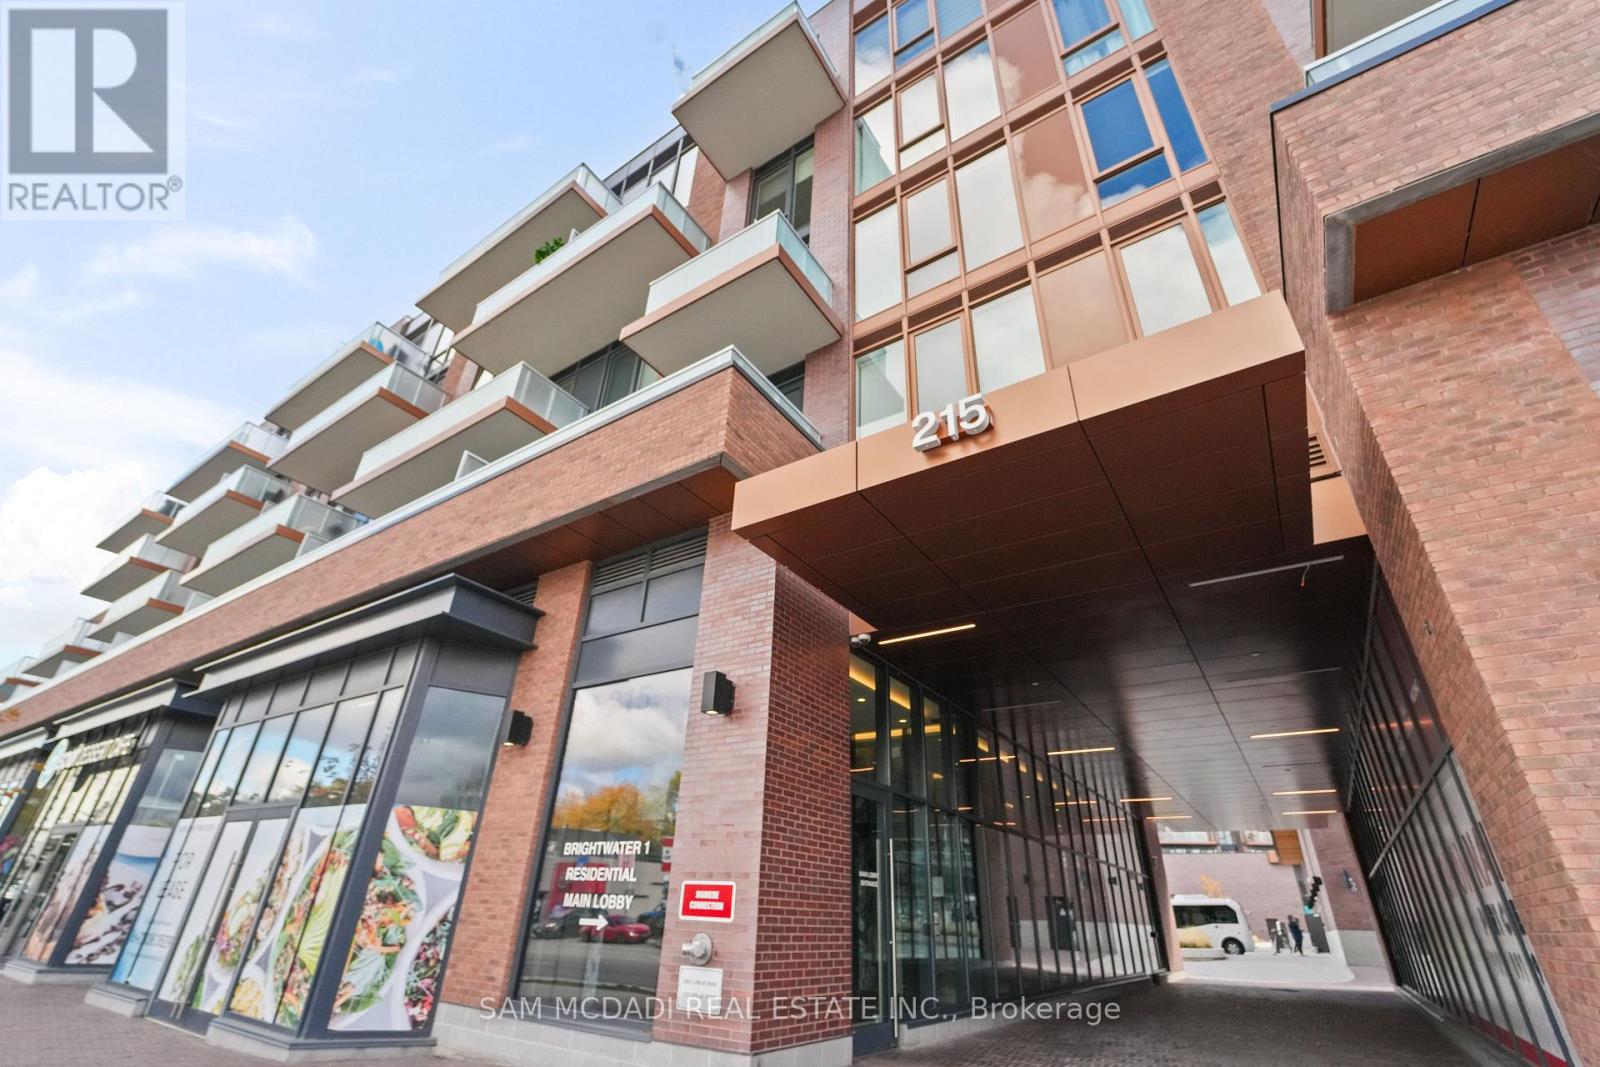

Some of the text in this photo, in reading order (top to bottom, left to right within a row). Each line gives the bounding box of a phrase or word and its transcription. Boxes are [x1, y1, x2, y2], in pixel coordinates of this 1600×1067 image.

[912, 393, 989, 452] 215
[563, 840, 651, 856] BRIGHTWATER 1
[565, 866, 637, 882] RESIDENTIAL
[562, 892, 634, 910] MAIN LOBBY
